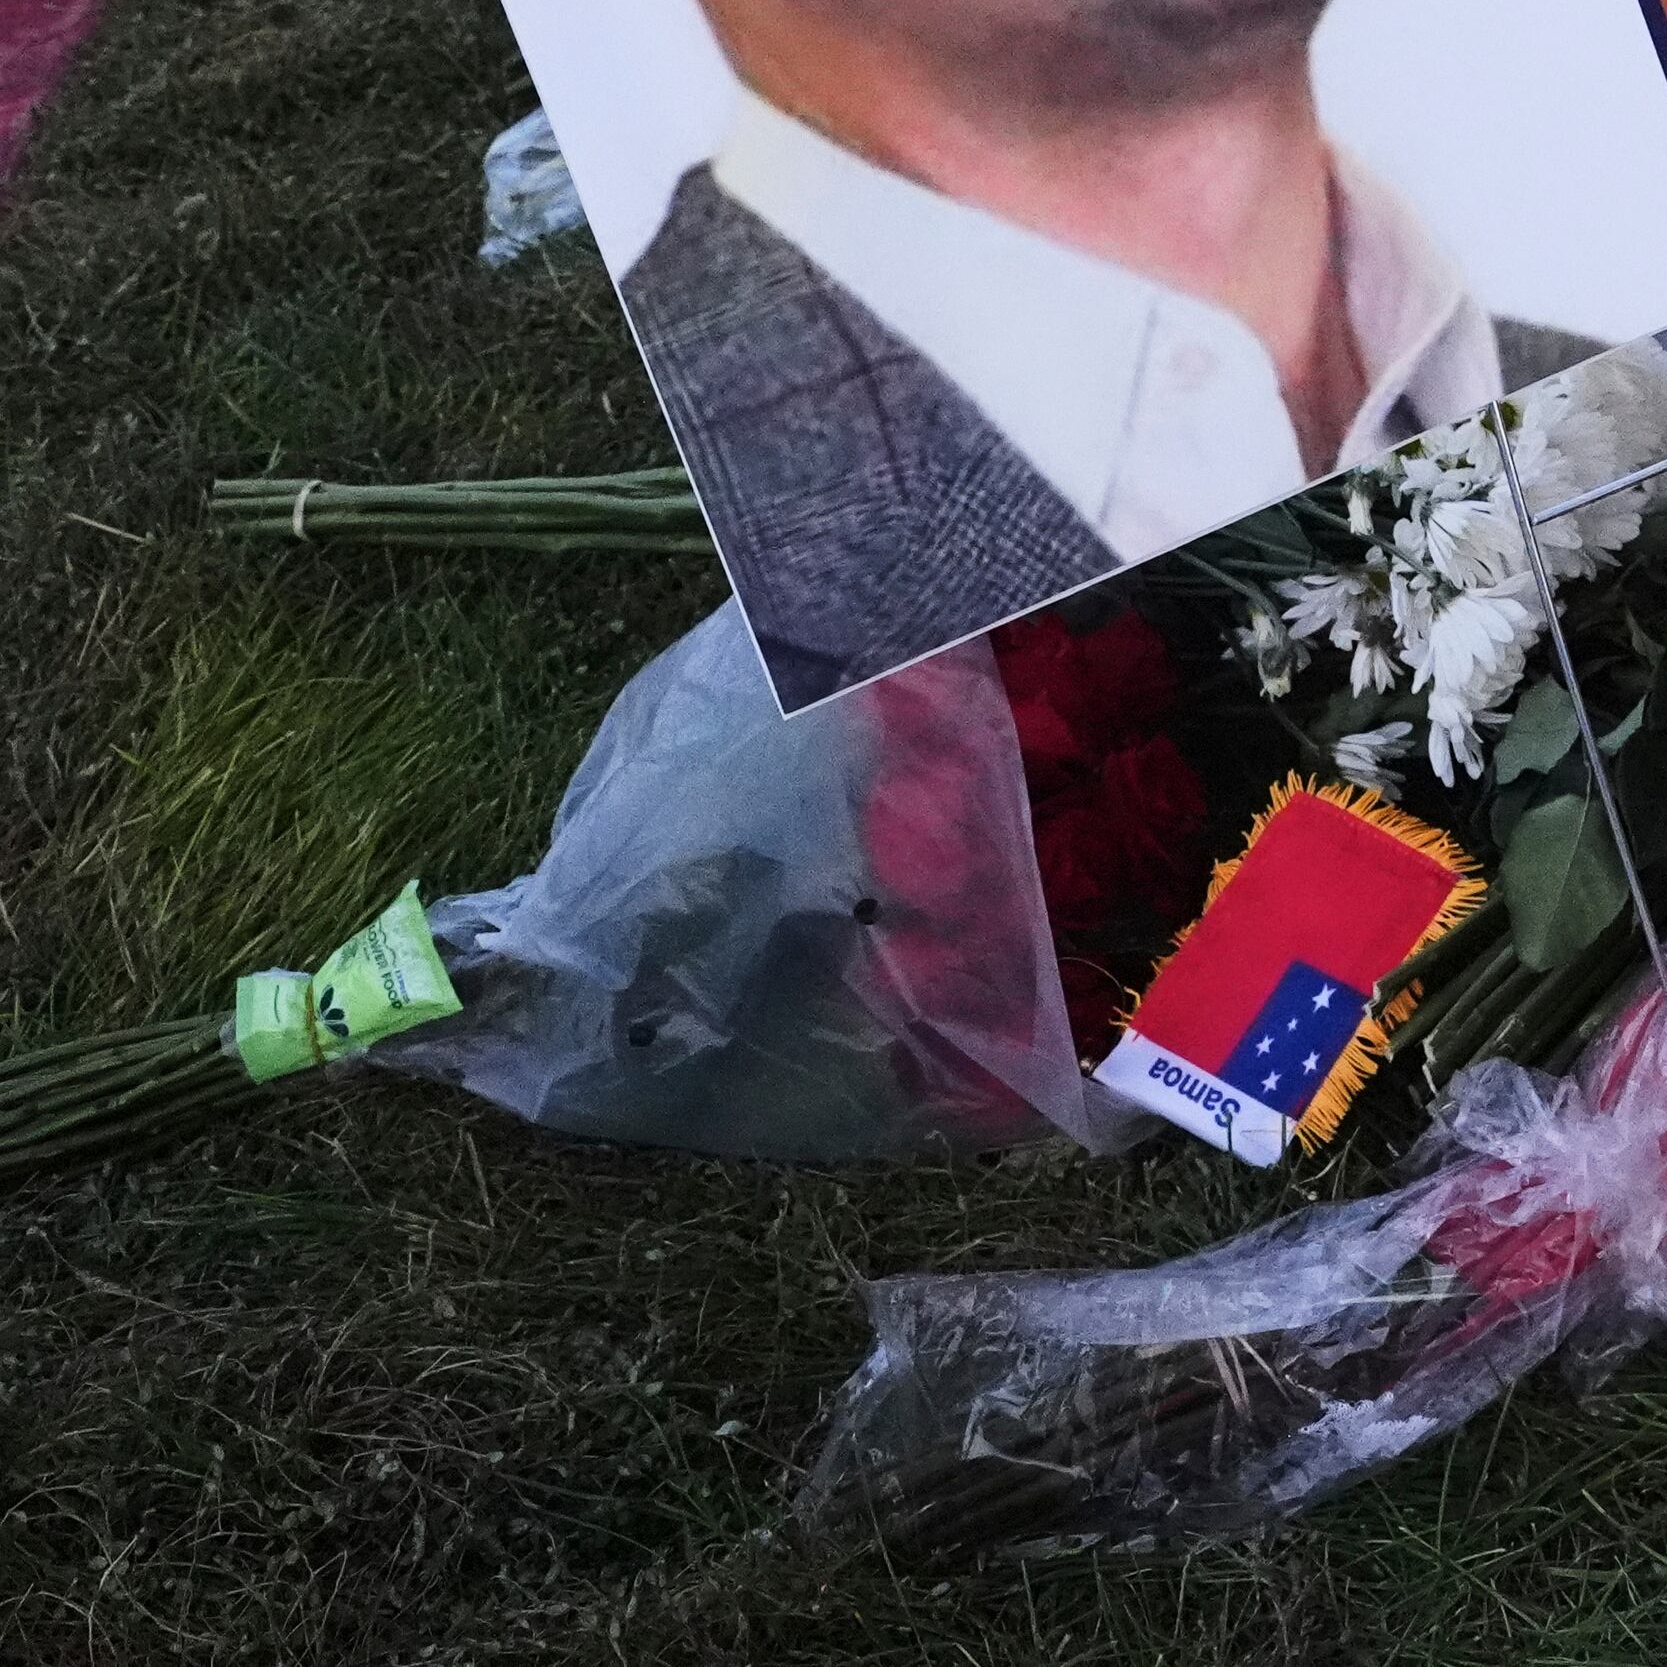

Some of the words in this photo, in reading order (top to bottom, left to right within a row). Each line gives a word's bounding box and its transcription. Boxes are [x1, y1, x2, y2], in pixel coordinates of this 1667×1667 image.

[368, 924, 388, 968] LOWER
[381, 971, 402, 1009] FOOD
[1148, 1056, 1241, 1129] Samoa
